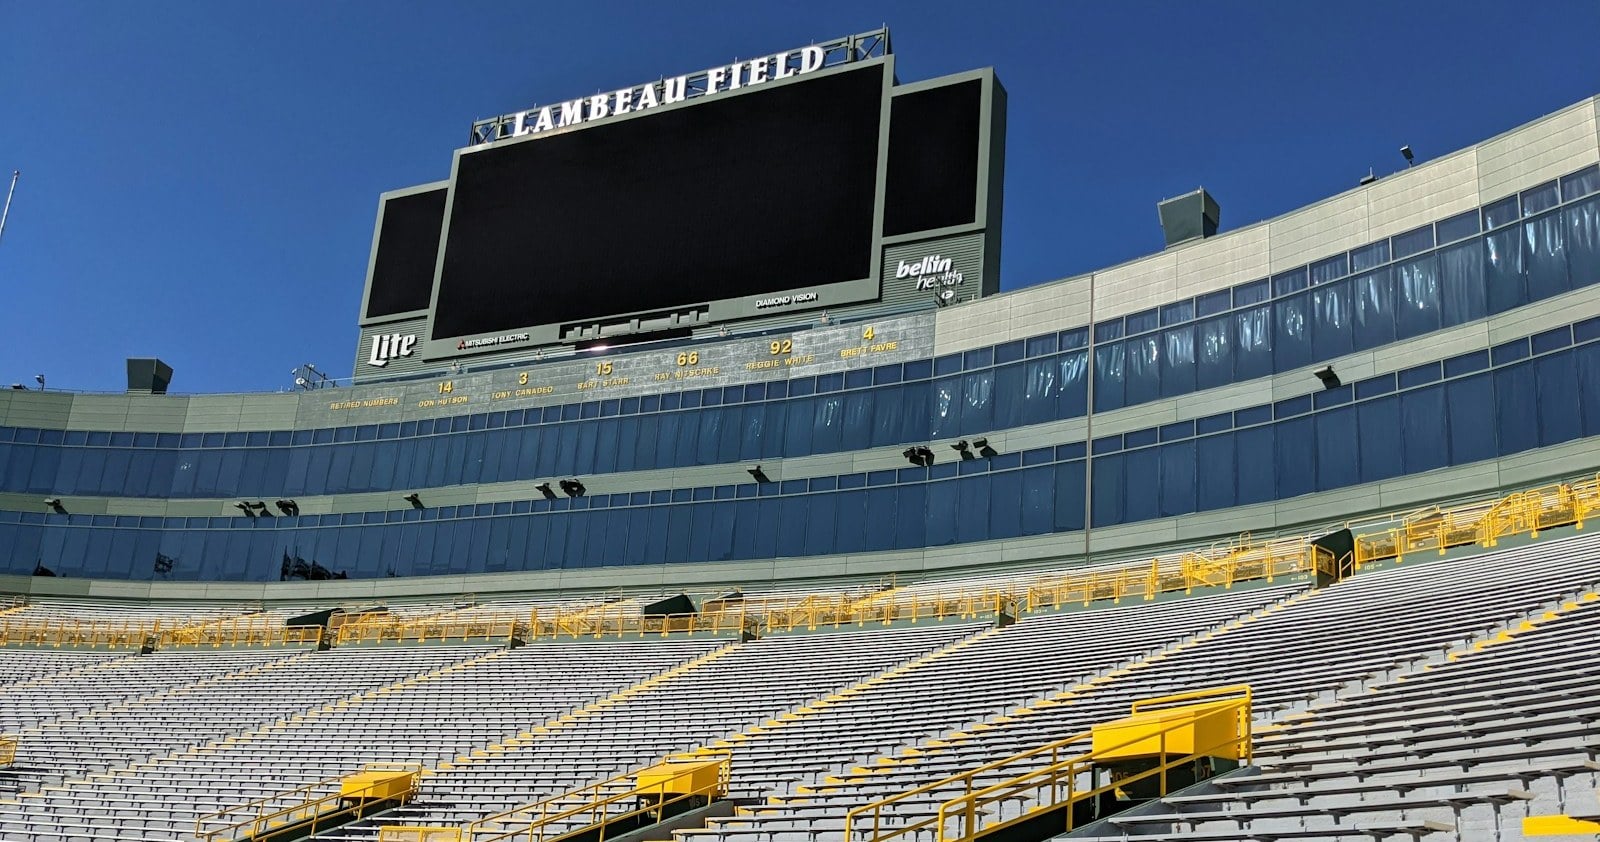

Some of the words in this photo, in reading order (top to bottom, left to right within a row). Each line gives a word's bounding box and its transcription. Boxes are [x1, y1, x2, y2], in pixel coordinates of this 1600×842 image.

[513, 75, 687, 137] LAMBEAU
[705, 46, 824, 96] FIELD
[896, 255, 952, 278] bellin
[755, 297, 790, 308] DIAMOND
[791, 292, 817, 302] VISION
[465, 337, 499, 346] MITSUBISHI
[499, 333, 529, 342] ELECTRIC
[863, 326, 875, 341] 4
[367, 333, 416, 366] Lite
[770, 339, 792, 356] 92
[840, 348, 869, 358] BRETT
[870, 342, 898, 352] FAVRE
[677, 351, 699, 366] 66
[746, 359, 780, 370] REGGIE
[784, 354, 815, 365] WHITE
[596, 362, 613, 376] 15
[519, 372, 529, 385] 3
[577, 382, 598, 390] BART
[602, 377, 630, 387] STARR
[654, 372, 671, 381] RAY
[438, 381, 454, 394] 14
[491, 390, 512, 399] TONY
[330, 401, 361, 410] RETIRED
[363, 397, 400, 407] NUMBERS
[418, 400, 435, 408] DON
[437, 396, 469, 406] HUTSON
